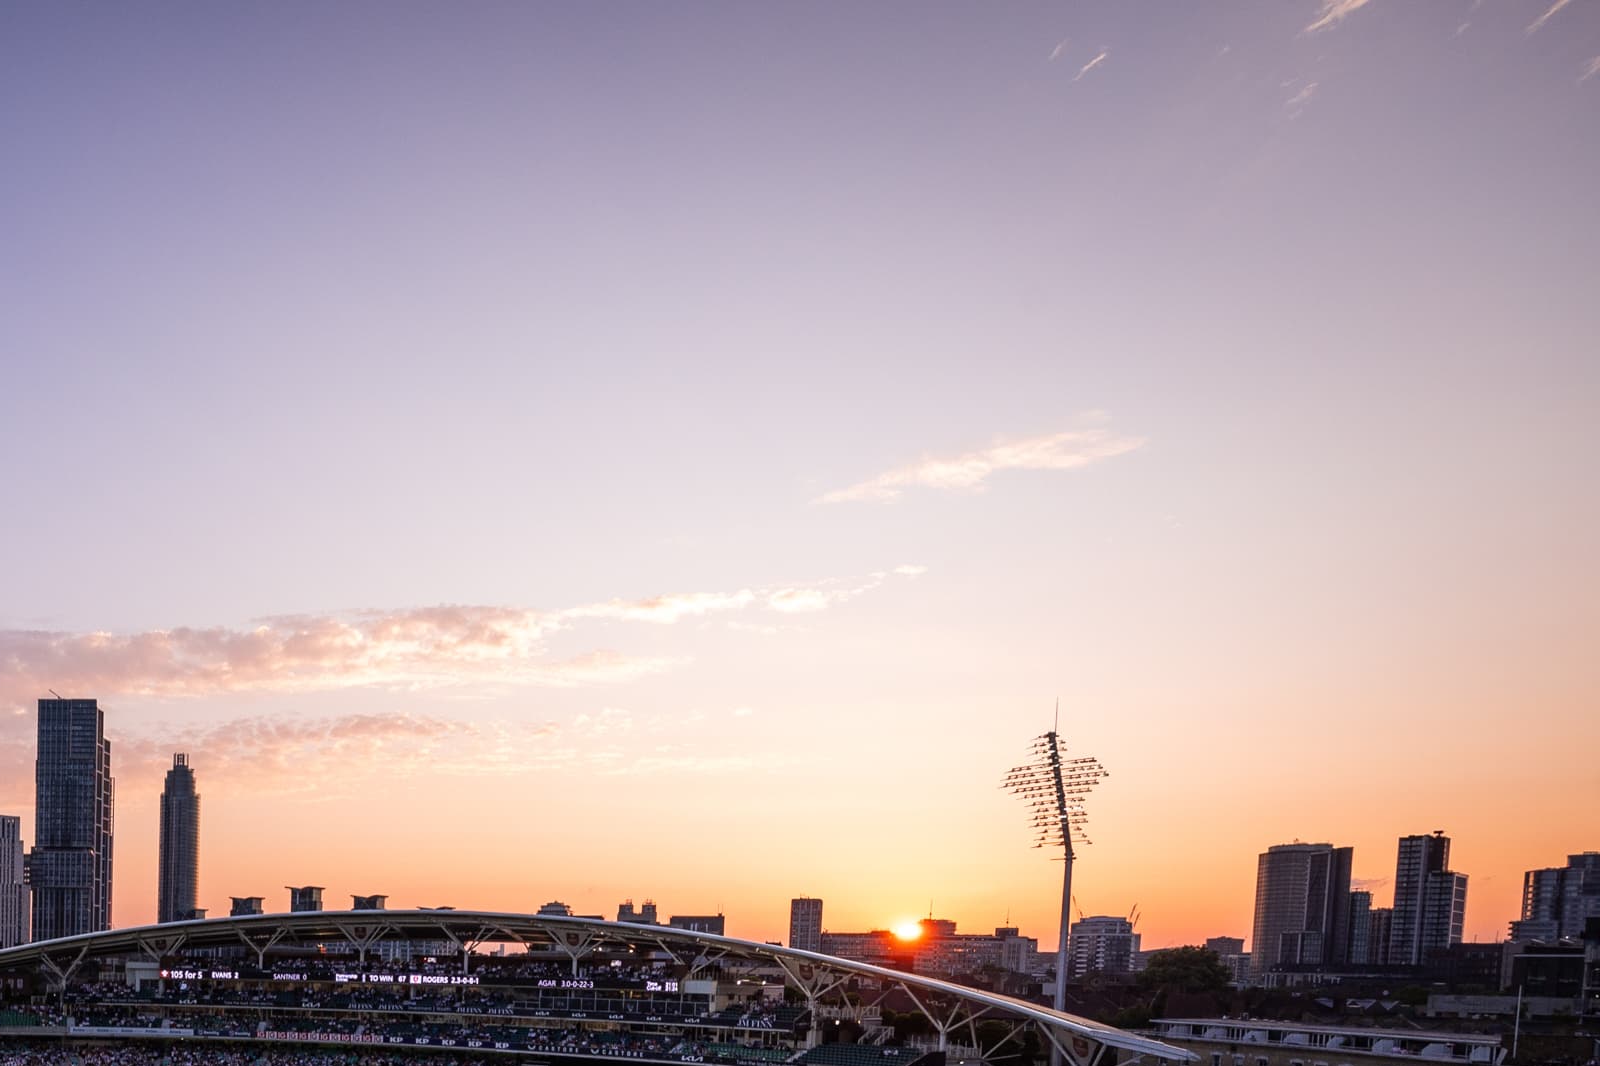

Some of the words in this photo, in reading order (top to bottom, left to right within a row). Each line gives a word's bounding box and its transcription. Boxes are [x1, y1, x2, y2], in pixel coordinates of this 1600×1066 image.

[171, 971, 184, 979] 105
[185, 970, 196, 979] for
[198, 971, 203, 979] 5
[212, 971, 232, 979] EVANS
[737, 1019, 750, 1027] JM
[751, 1019, 773, 1028] FINN
[538, 1046, 579, 1054] CASTORE
[601, 1049, 644, 1058] CASTORE
